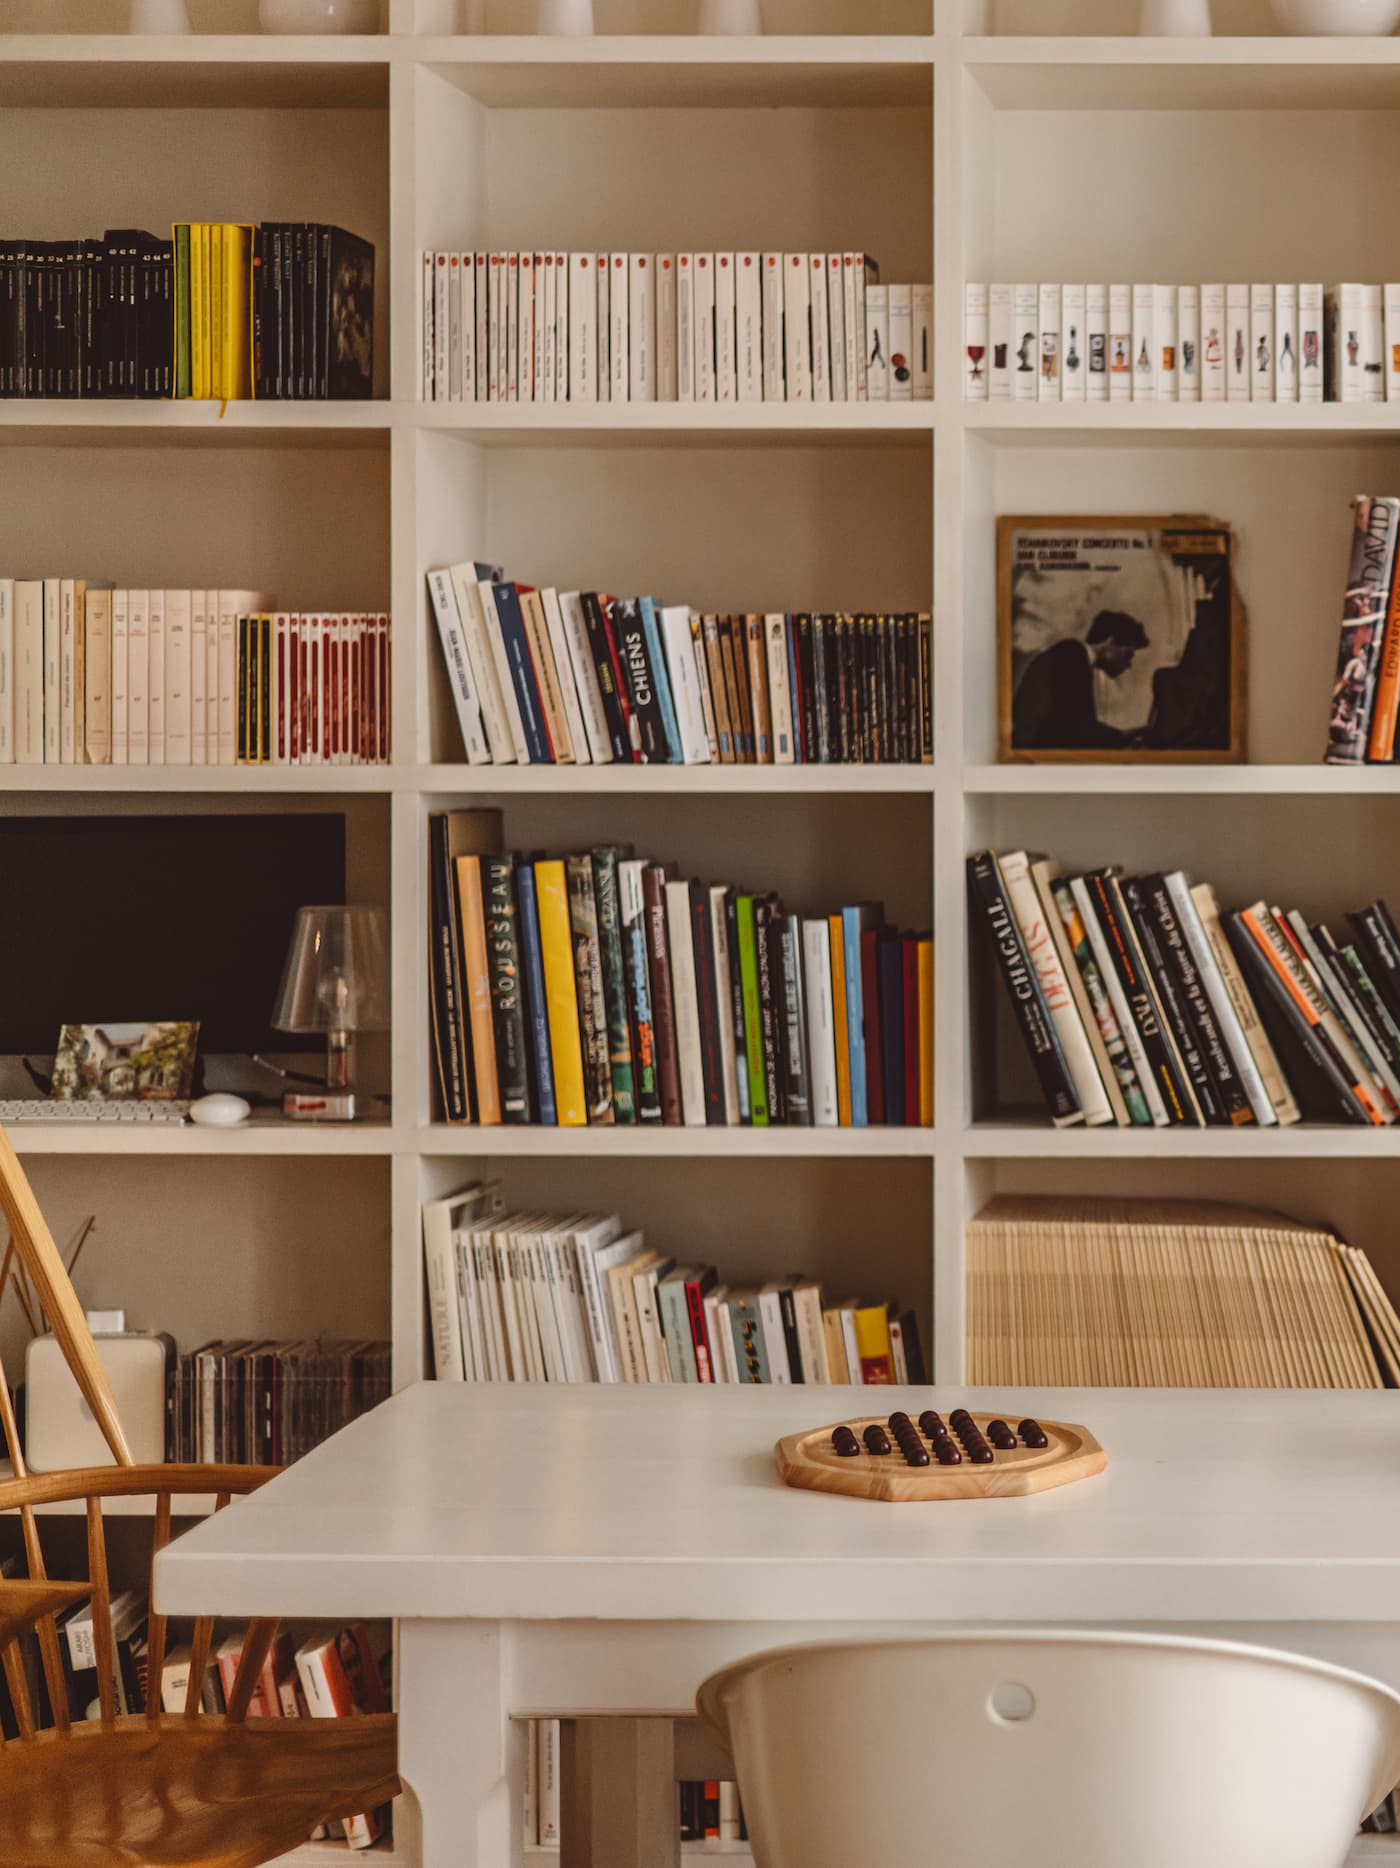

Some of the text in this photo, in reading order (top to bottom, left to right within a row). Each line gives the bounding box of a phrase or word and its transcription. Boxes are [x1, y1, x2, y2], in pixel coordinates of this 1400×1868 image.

[1358, 502, 1391, 584] DAVID
[625, 631, 652, 706] CHIENS
[489, 863, 515, 1009] ROUSSEAU
[986, 896, 1034, 1001] CHAGALL
